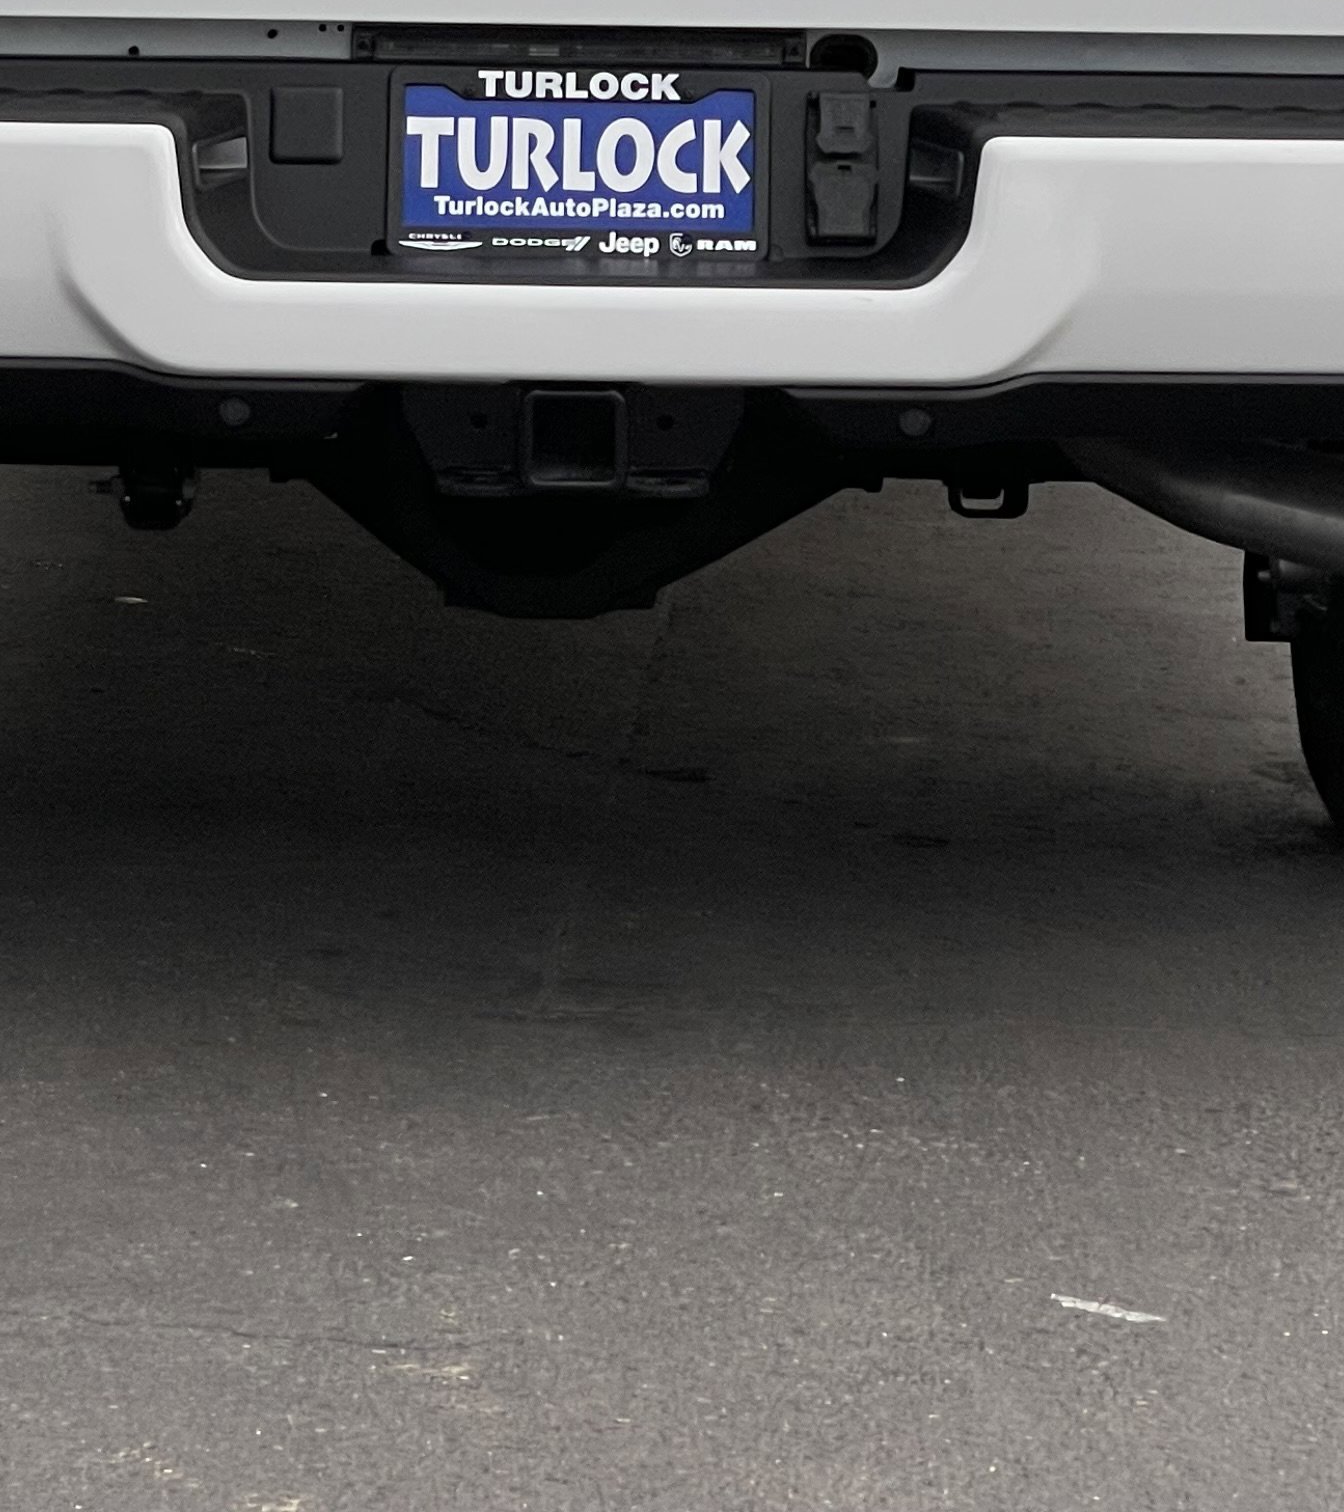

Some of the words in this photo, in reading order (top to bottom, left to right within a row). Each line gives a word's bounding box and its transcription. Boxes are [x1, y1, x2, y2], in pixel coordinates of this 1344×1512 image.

[478, 70, 681, 101] TURLOCK
[406, 116, 751, 194] TURLOCK
[434, 195, 725, 220] TurlockAutoPlaza.com
[408, 232, 467, 240] CHRYSLE
[599, 232, 660, 257] Jeep
[697, 239, 757, 251] RAM
